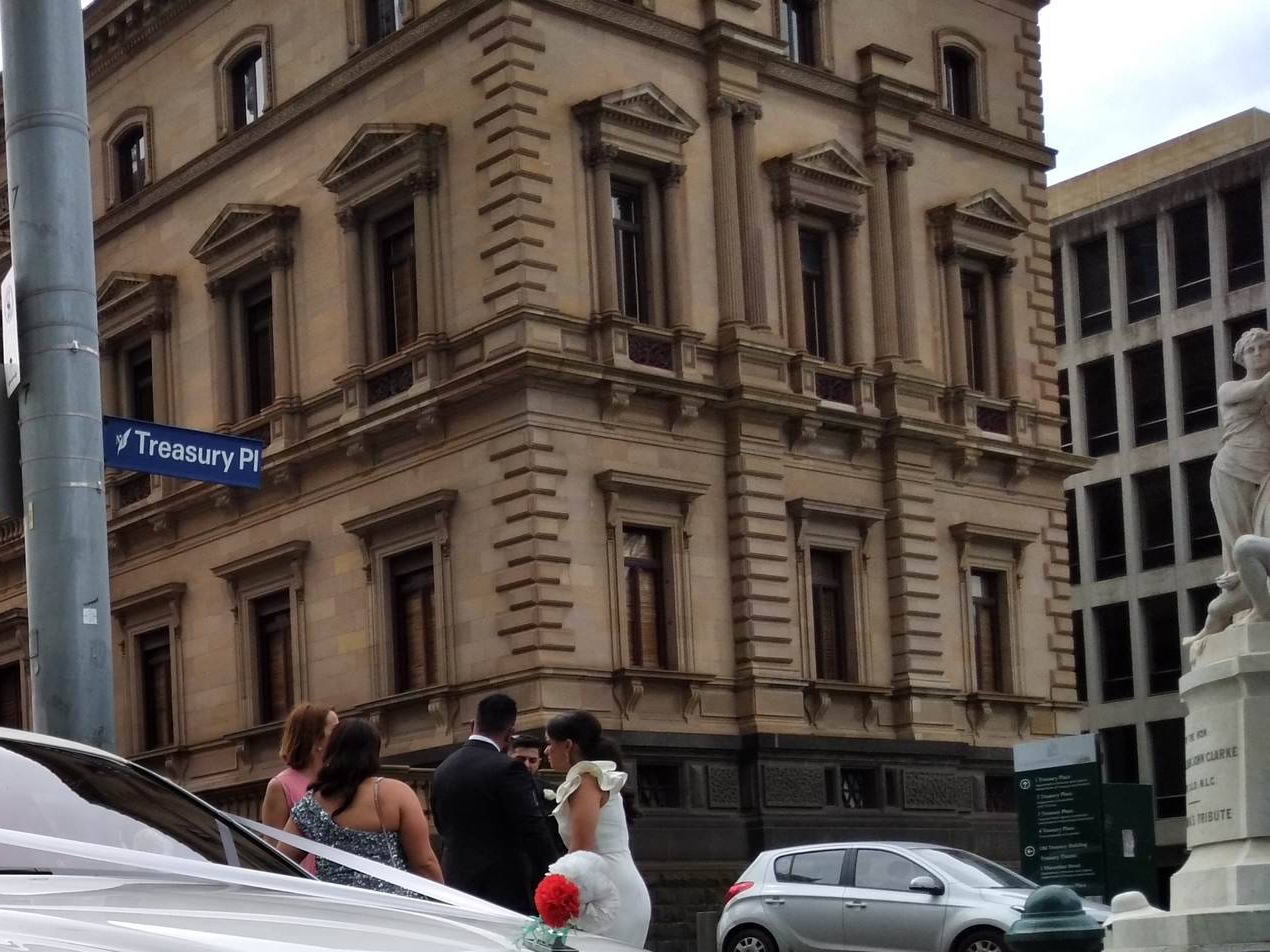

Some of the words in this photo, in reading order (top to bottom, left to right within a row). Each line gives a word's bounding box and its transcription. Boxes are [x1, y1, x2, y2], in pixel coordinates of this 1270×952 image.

[134, 429, 234, 472] Treasury
[239, 447, 259, 472] Pl
[1206, 746, 1238, 762] CLARKE
[1197, 808, 1232, 824] TRIBUTE
